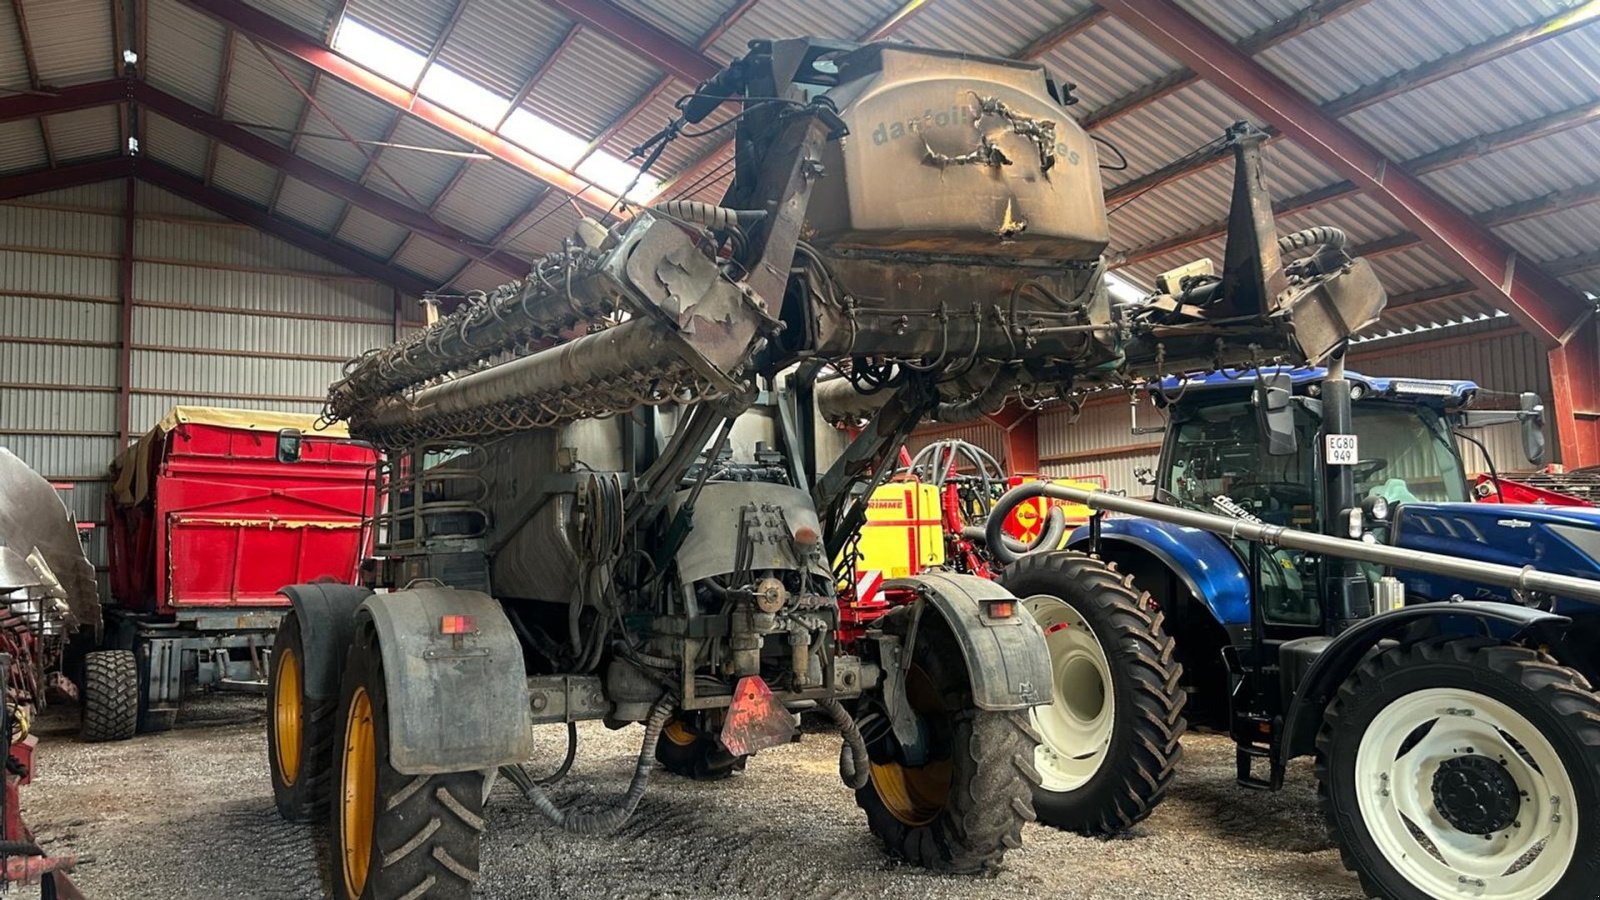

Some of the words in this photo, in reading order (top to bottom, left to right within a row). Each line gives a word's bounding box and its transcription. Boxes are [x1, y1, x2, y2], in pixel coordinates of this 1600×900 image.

[1330, 437, 1354, 449] EG80
[1333, 450, 1351, 461] 949
[867, 500, 903, 509] RIMME
